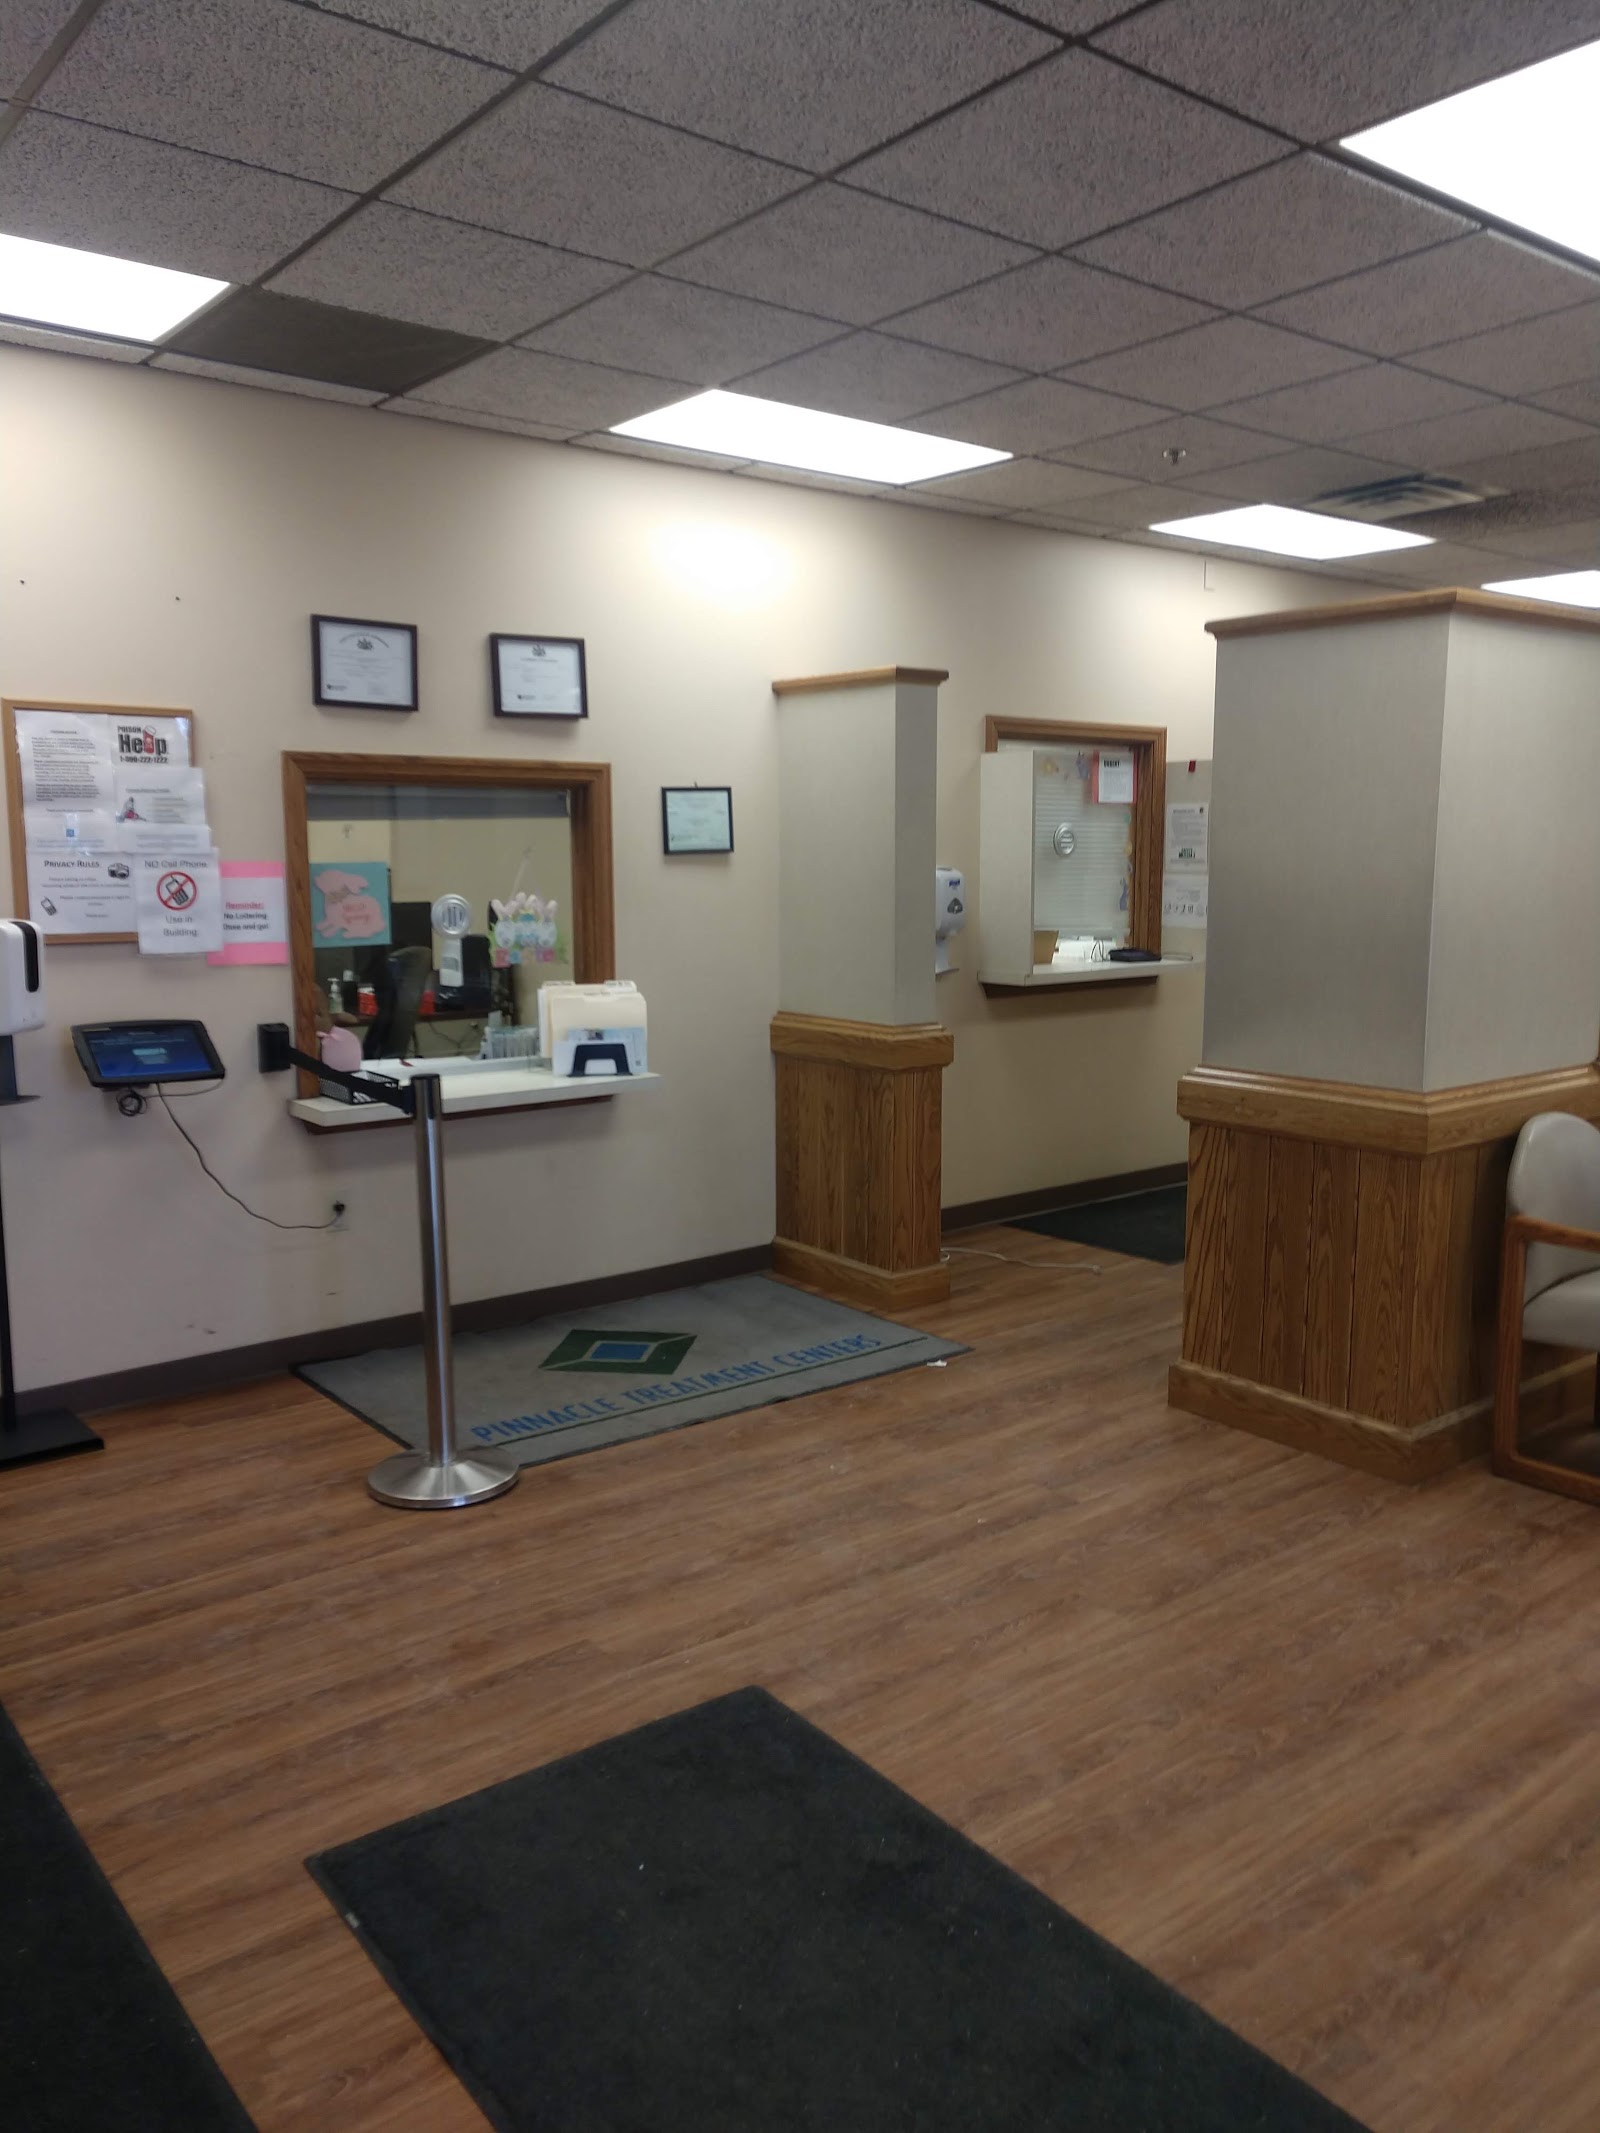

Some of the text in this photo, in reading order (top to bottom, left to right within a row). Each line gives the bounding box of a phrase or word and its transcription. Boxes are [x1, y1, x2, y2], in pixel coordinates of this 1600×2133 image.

[117, 725, 142, 734] POISON
[77, 860, 100, 868] RULES
[144, 860, 207, 868] NO Cell Phone
[165, 915, 183, 924] Use
[471, 1334, 882, 1441] PINNACLE TREATMENT CENTERS
